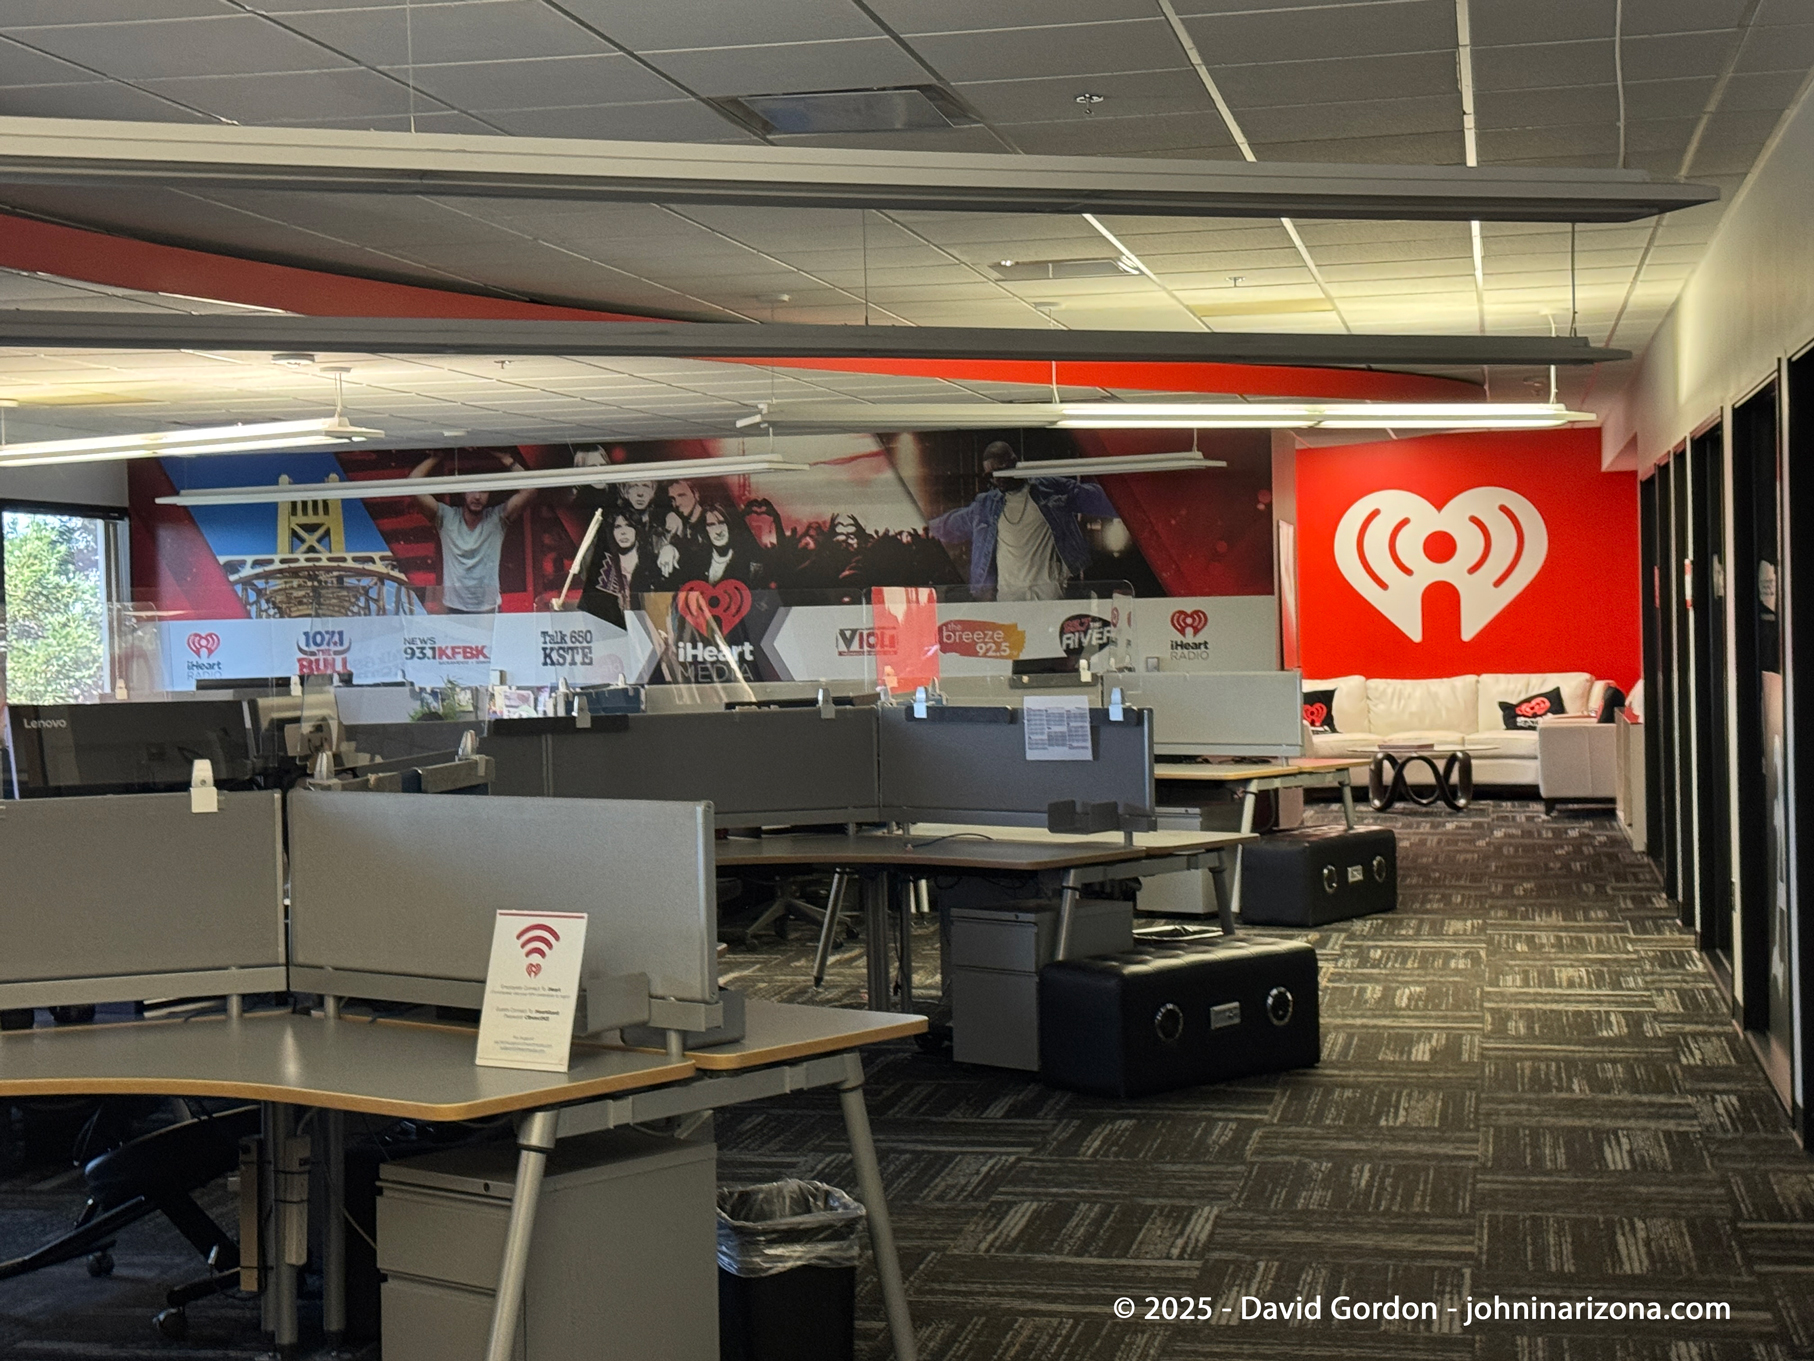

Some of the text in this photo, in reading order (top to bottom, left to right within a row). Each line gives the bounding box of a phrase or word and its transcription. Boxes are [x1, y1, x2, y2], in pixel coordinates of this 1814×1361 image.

[403, 636, 436, 646] NEWS
[540, 629, 593, 645] Talk 650
[942, 625, 1005, 643] breeze
[1062, 627, 1112, 651] RIVER
[677, 641, 755, 663] iHeart
[975, 642, 1011, 656] 92.5
[1170, 640, 1209, 651] iHeart
[541, 646, 594, 667] KSTE
[1170, 651, 1210, 661] RADIO
[187, 660, 222, 671] iHeart
[296, 656, 350, 675] BULL
[23, 717, 68, 729] Lenovo
